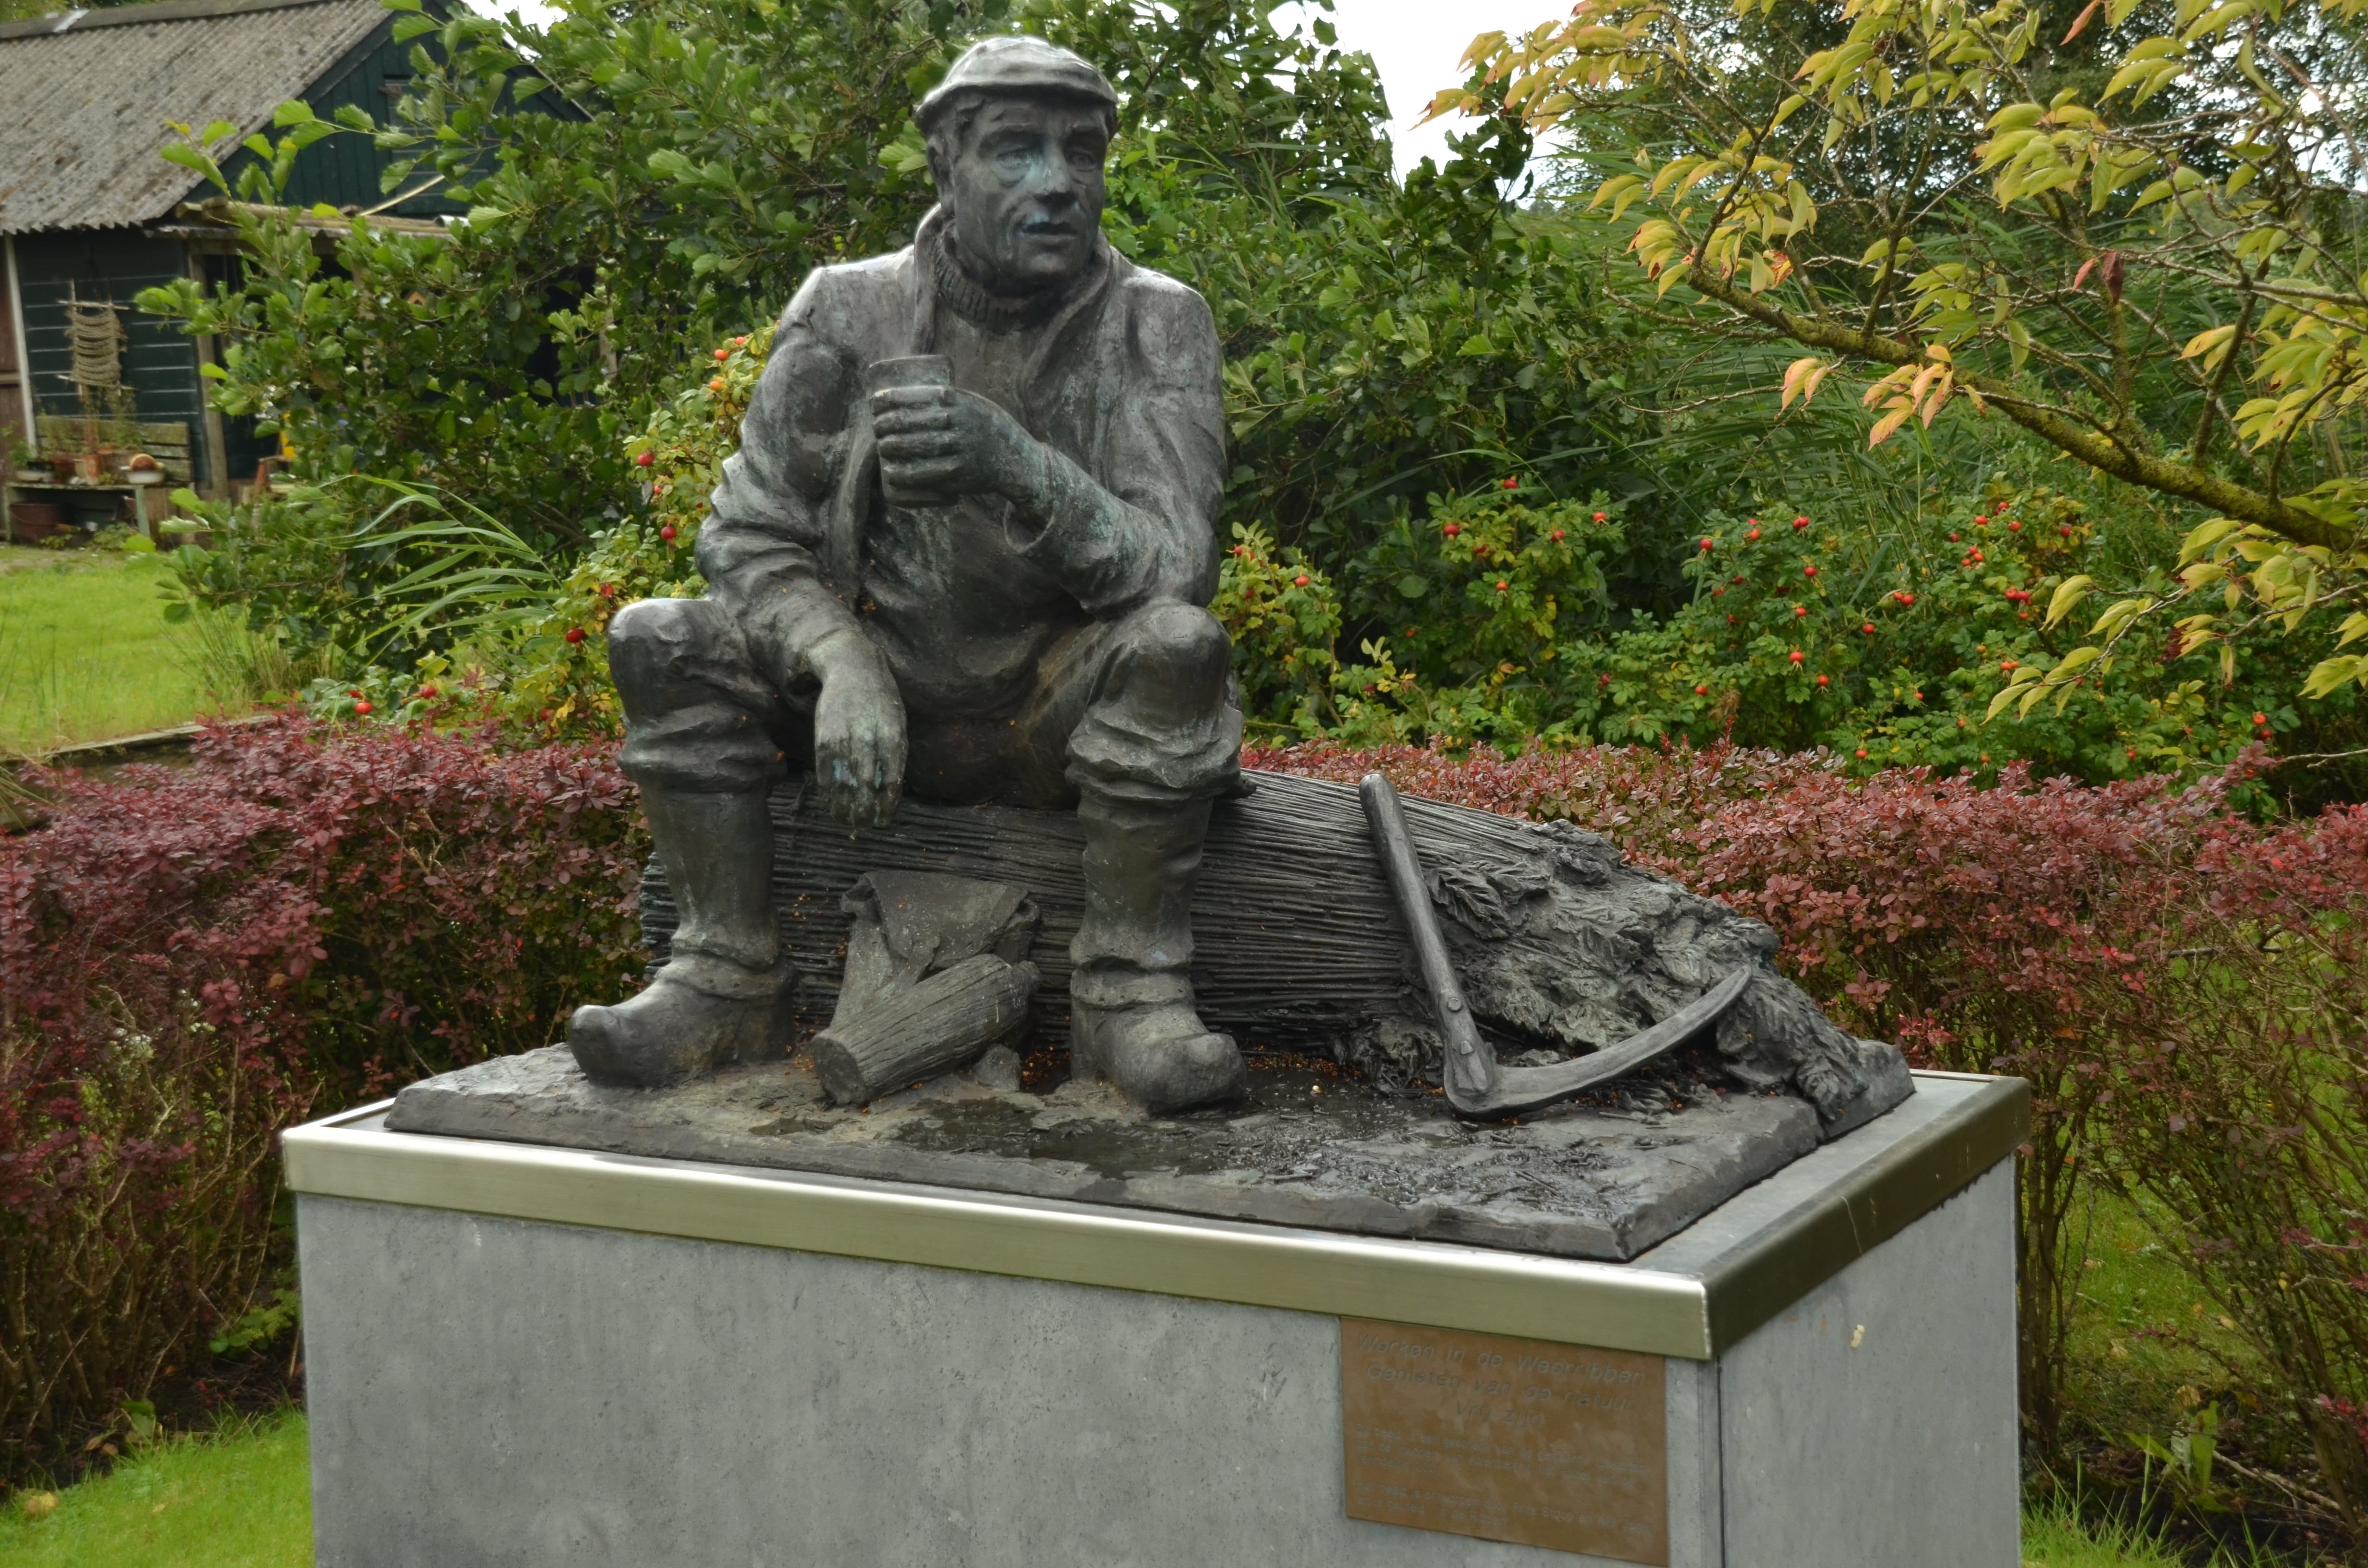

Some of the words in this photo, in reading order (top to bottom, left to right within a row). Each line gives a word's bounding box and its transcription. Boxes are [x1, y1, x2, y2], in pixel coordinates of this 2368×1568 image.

[1357, 1334, 1435, 1360] Werken
[1446, 1345, 1465, 1364] in
[1477, 1349, 1503, 1369] de
[1517, 1353, 1645, 1388] Weerribben
[1366, 1361, 1461, 1391] Genieten
[1523, 1383, 1552, 1402] de
